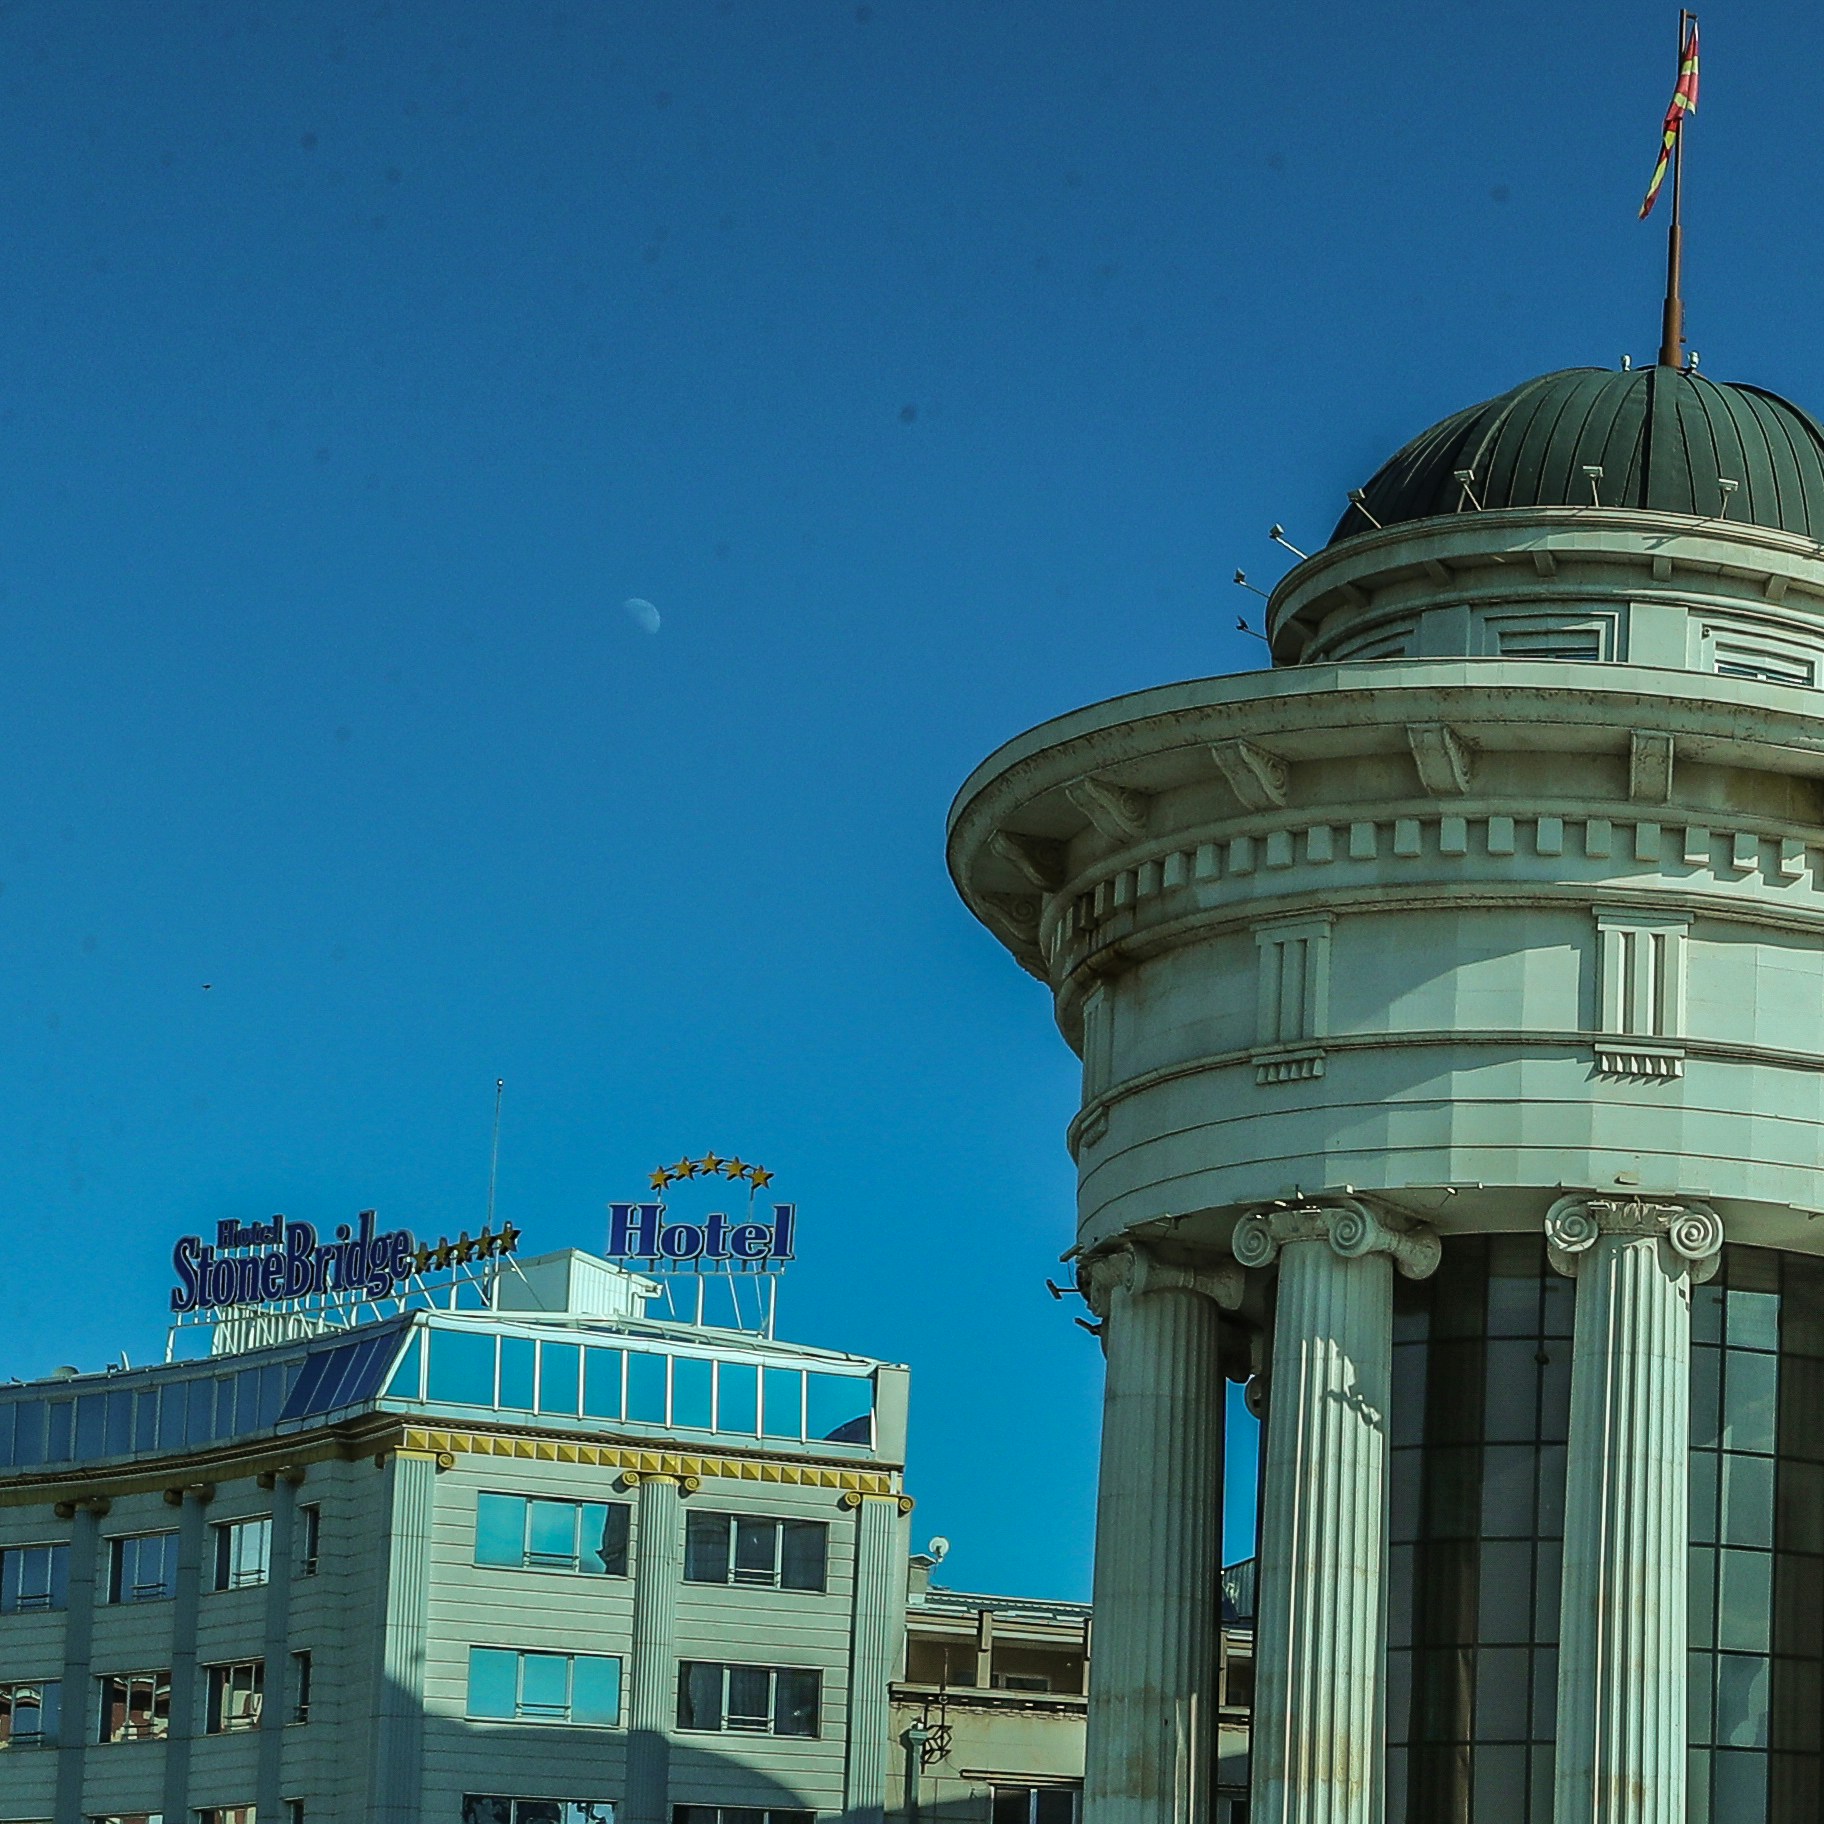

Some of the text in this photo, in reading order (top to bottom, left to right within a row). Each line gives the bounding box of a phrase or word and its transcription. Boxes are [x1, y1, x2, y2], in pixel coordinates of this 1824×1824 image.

[170, 1209, 415, 1313] StoneBridge
[216, 1214, 286, 1250] Hotel
[606, 1203, 796, 1261] Hotel
